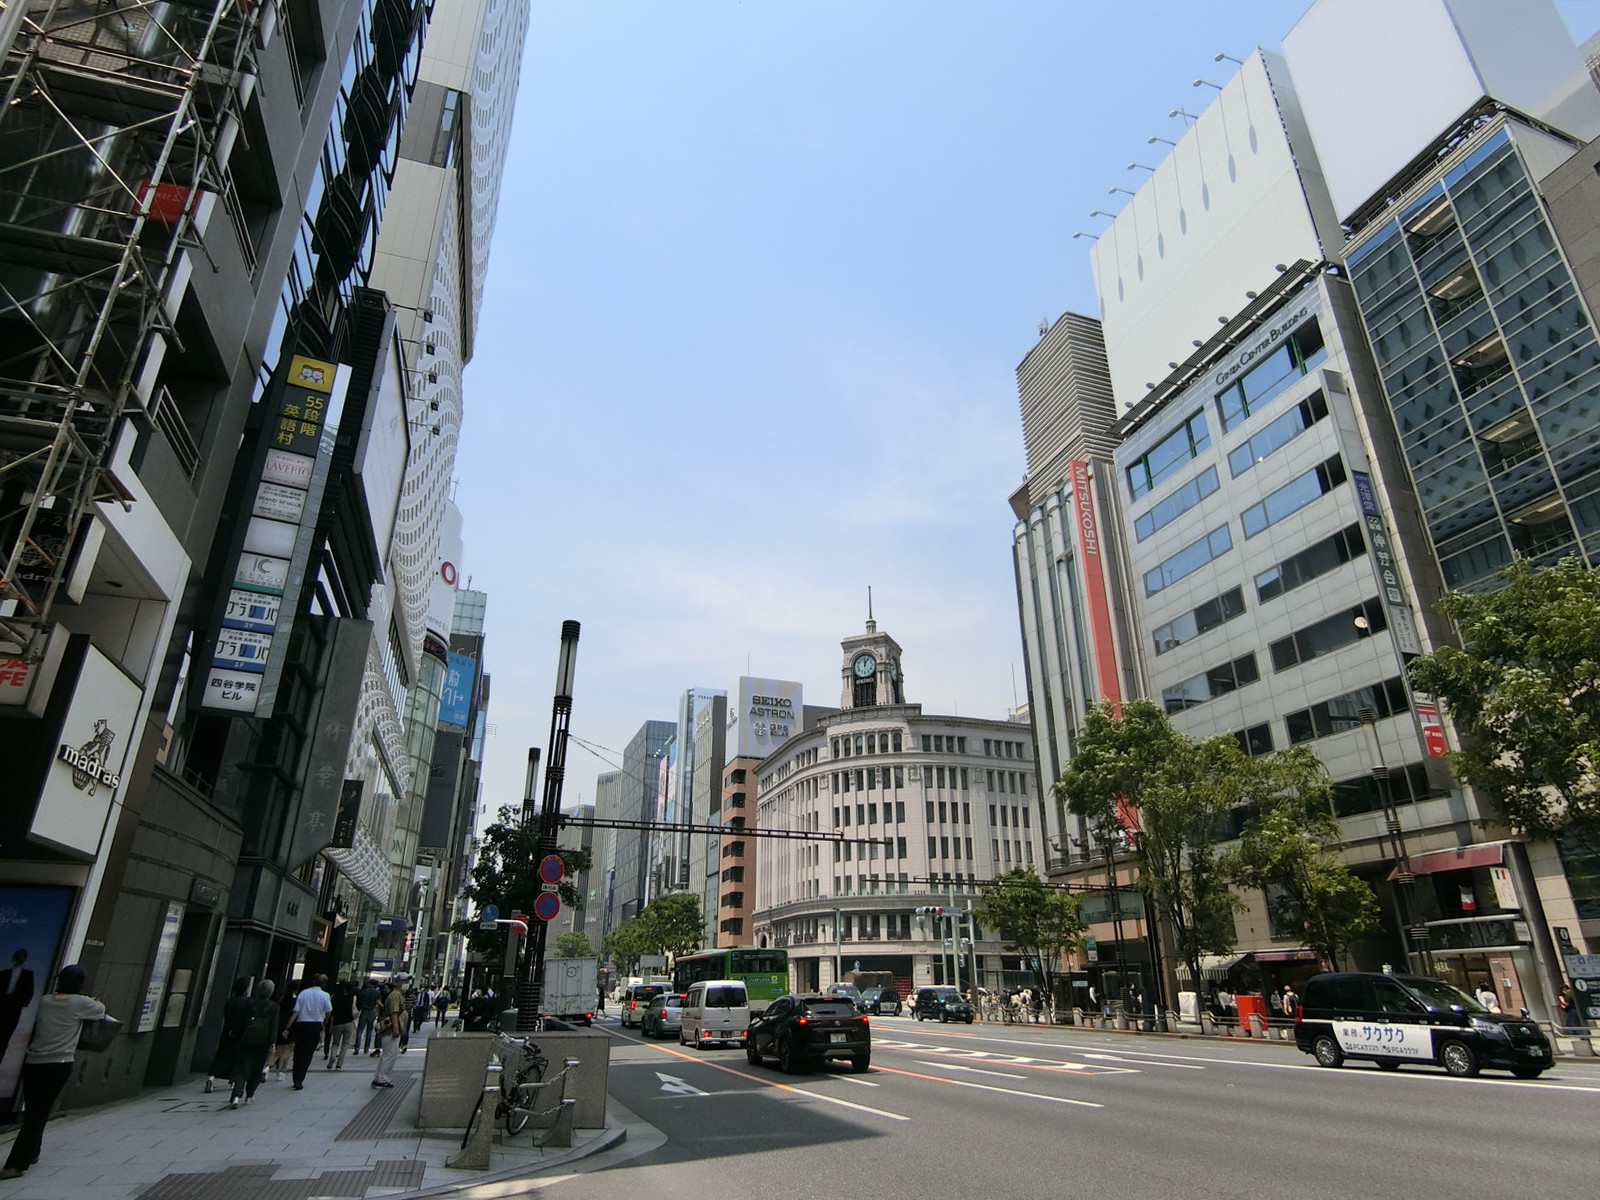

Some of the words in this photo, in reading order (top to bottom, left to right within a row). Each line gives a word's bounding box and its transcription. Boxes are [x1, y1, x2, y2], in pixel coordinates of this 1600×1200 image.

[1216, 363, 1241, 385] GINZA
[1240, 338, 1271, 369] CENTER
[1270, 306, 1308, 342] BUILDING
[277, 403, 301, 445] 英語村
[1074, 466, 1096, 556] MITSUKOSHI
[239, 569, 283, 584] KENZO
[211, 678, 256, 691] 四谷学院
[856, 677, 875, 685] SEIKO
[222, 691, 242, 700] ビル
[752, 695, 792, 707] SEIKO
[749, 707, 794, 719] ASTRON
[62, 745, 121, 789] madras
